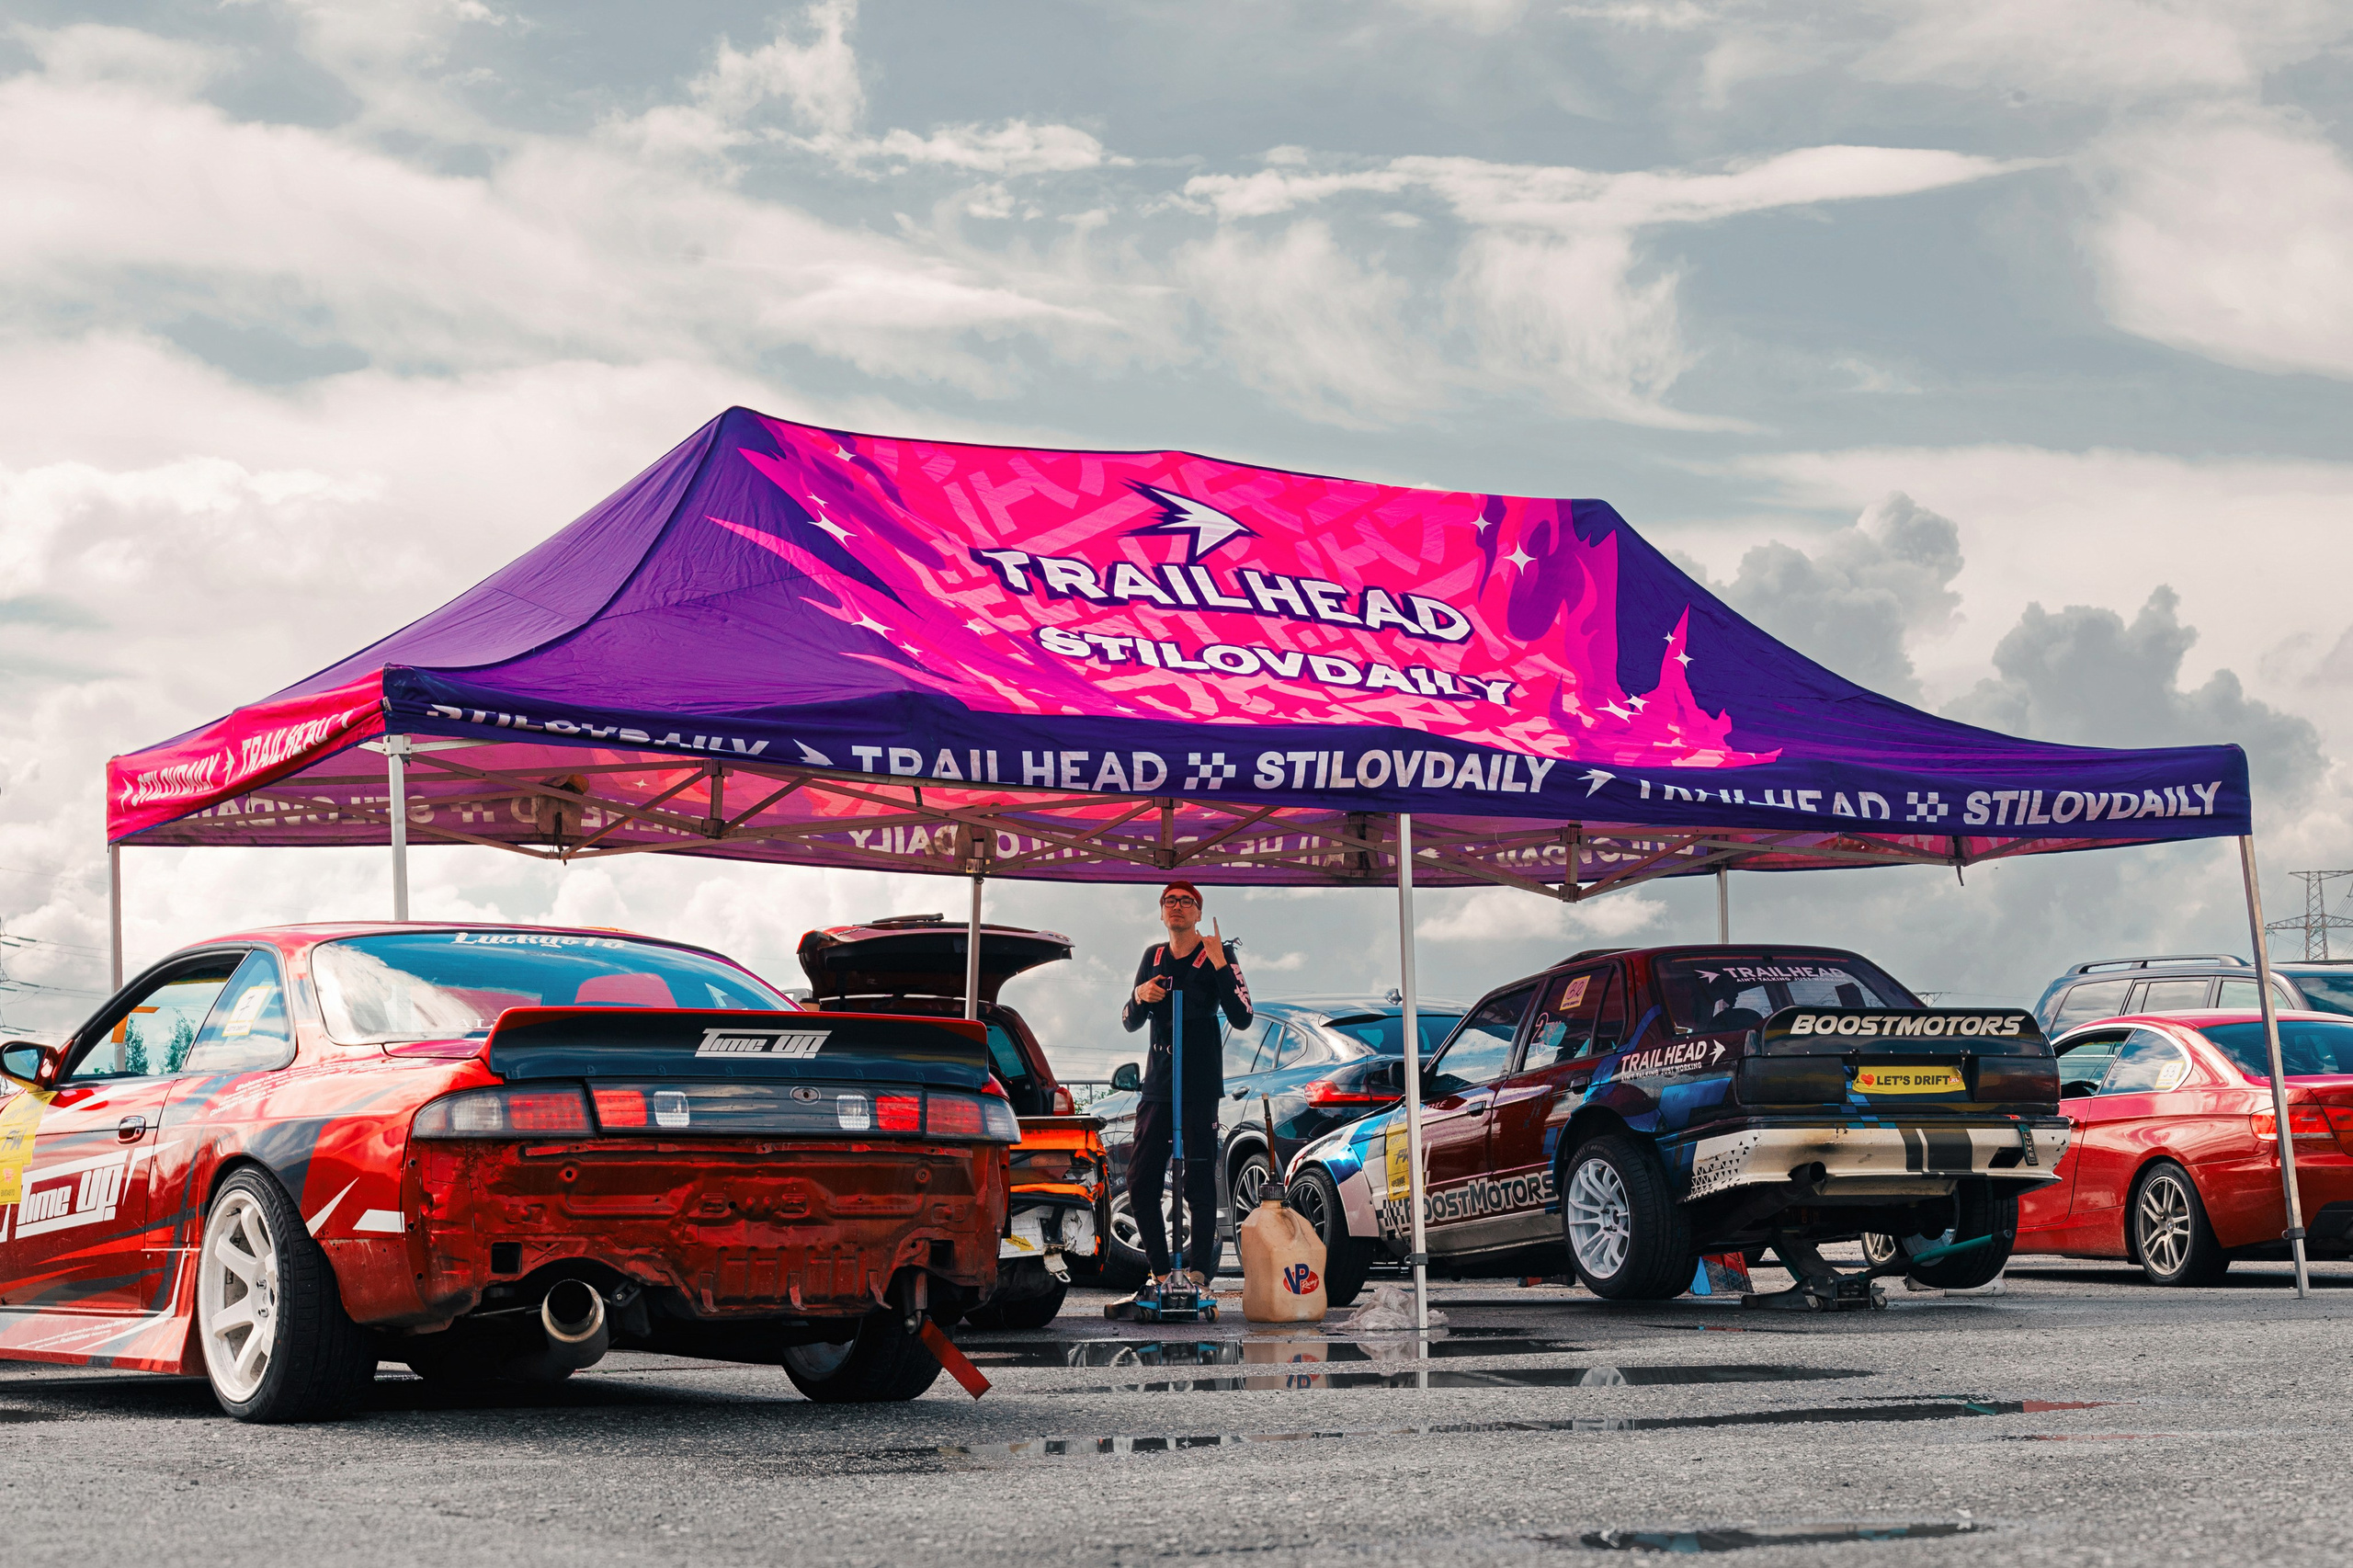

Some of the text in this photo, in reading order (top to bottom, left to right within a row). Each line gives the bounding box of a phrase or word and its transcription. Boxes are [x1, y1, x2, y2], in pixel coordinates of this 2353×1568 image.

[974, 549, 1472, 642] TRAILHEAD
[1037, 626, 1516, 704] STILOVDAILY
[1254, 751, 1556, 792] STILOVDAILY
[1962, 781, 2222, 825] STILOVDAILY
[1722, 967, 1847, 979] TRAILHEAD
[1790, 1014, 2026, 1037] BOOSTMOTORS
[1621, 1040, 1708, 1074] TRAILHEAD
[1877, 1075, 1911, 1085] LET'S
[1283, 1263, 1310, 1295] VP
